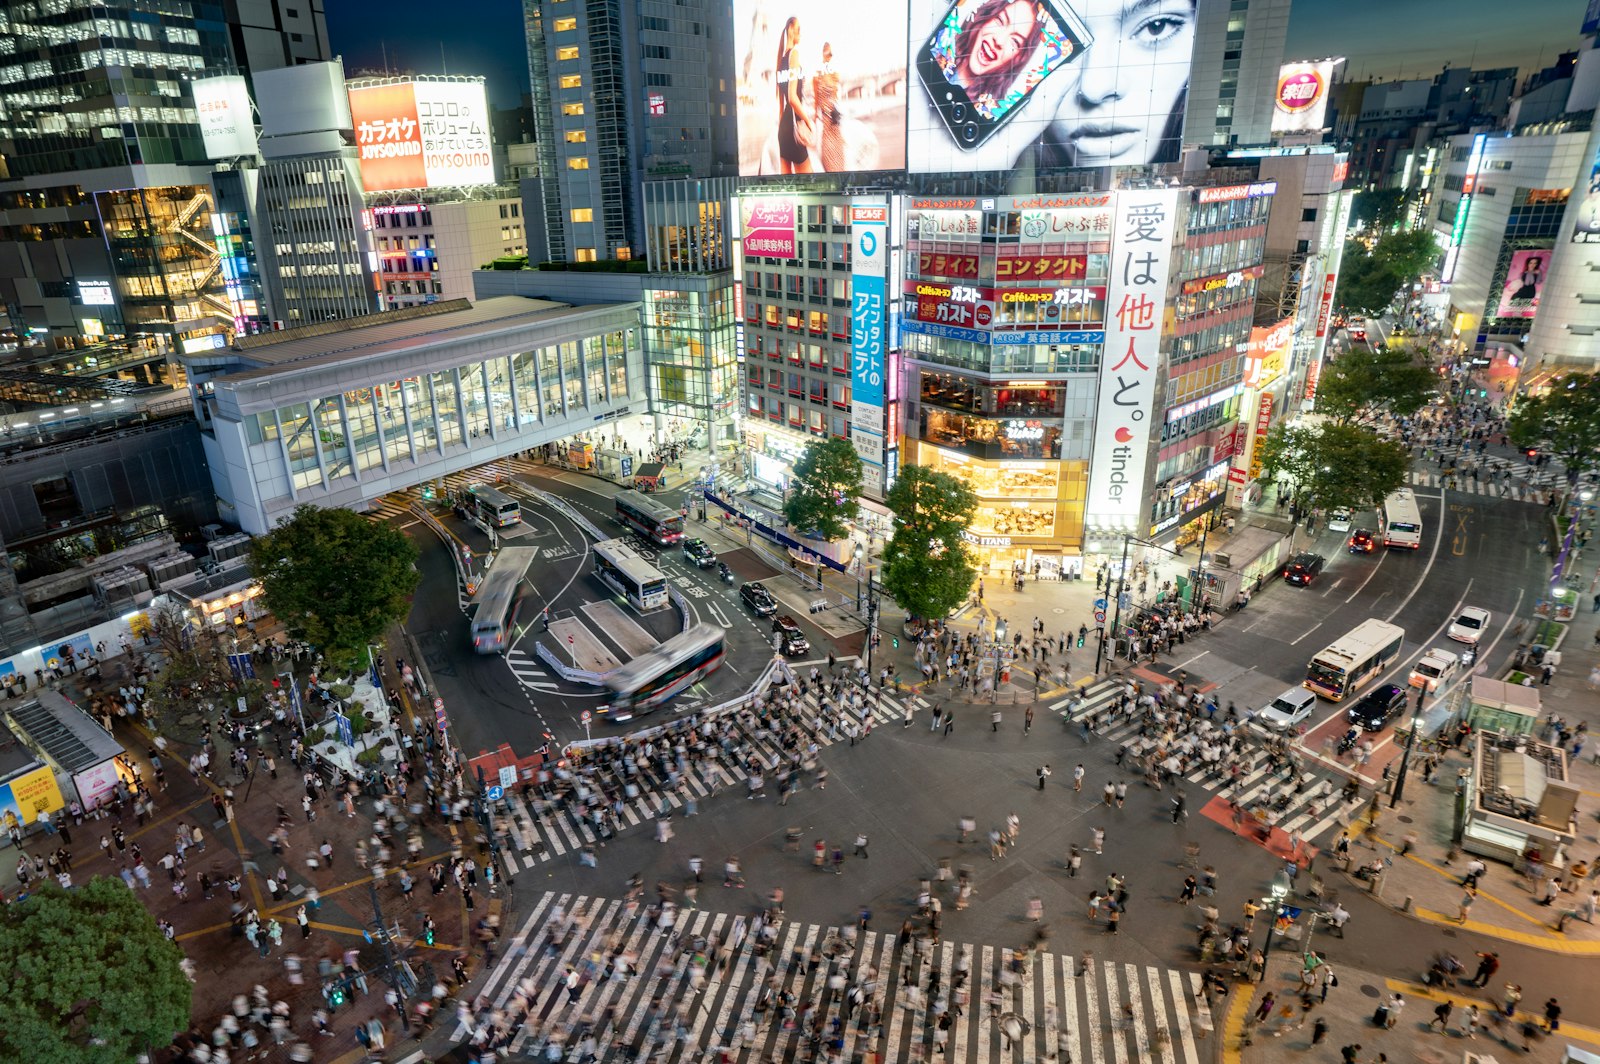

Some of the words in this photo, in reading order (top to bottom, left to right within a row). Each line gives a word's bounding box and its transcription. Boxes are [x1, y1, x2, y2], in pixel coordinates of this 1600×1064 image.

[419, 102, 470, 117] ココロの
[358, 117, 417, 143] カラオケ
[423, 119, 486, 136] ボリューム、
[361, 140, 421, 160] JOYSOUND
[424, 137, 489, 151] あげていこう。
[426, 153, 490, 169] JOYSOUND
[911, 199, 977, 209] しゃぶしゃぶバイキング
[1013, 196, 1111, 209] しゃぶしゃぶバイキング
[908, 219, 919, 230] 9F
[940, 217, 978, 234] しゃぶ葉
[1052, 214, 1109, 233] しゃぶ葉
[750, 239, 792, 252] 品川美容外科
[920, 255, 978, 274] プライス
[997, 258, 1085, 275] コンタクト
[951, 285, 981, 303] ガスト
[1054, 288, 1096, 304] ガスト
[906, 302, 918, 313] 7F
[936, 302, 972, 324] ガスト
[1111, 202, 1165, 421] 愛は他人と。
[855, 291, 869, 384] アイシティ
[870, 293, 880, 386] コンタクトの
[925, 324, 975, 340] 英会話イーオン
[1027, 332, 1102, 343] 英会話イーオン
[1108, 445, 1132, 504] tinder
